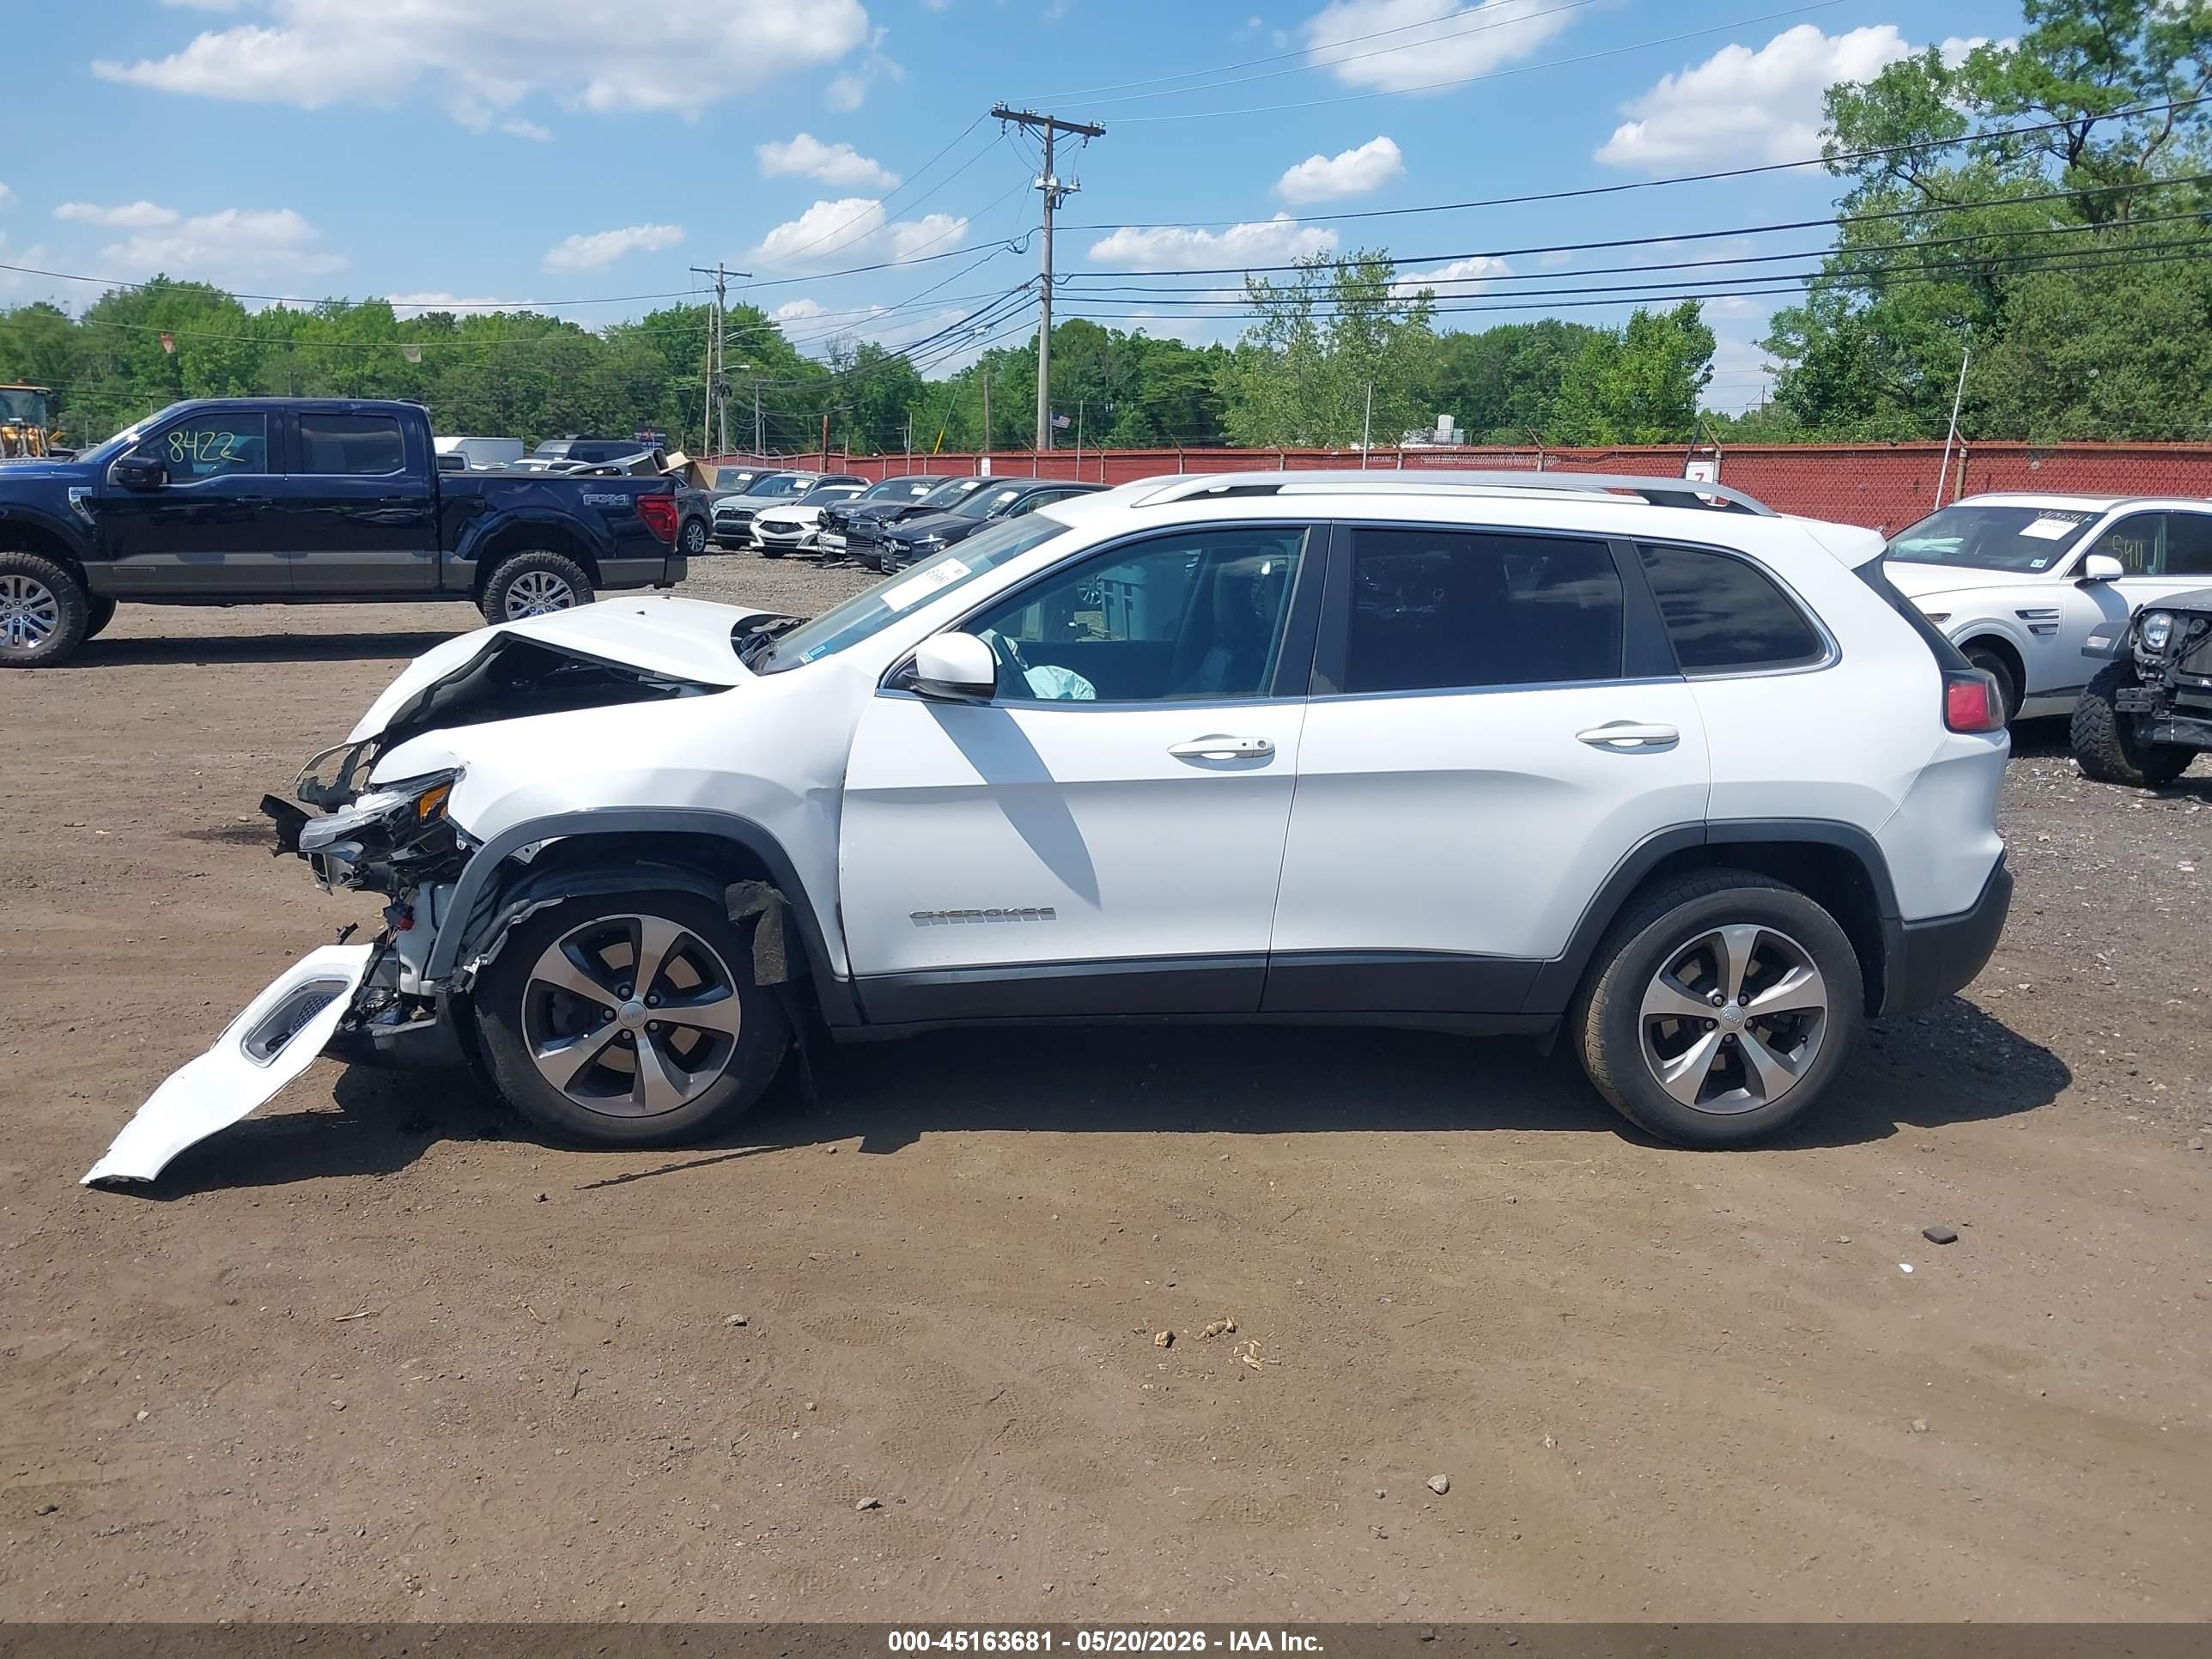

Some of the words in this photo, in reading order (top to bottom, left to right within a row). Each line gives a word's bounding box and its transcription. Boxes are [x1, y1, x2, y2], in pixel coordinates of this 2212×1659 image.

[168, 430, 246, 463] 8422
[583, 494, 629, 506] FX4
[2112, 534, 2143, 570] 5411
[908, 907, 1057, 921] CHEROKEE
